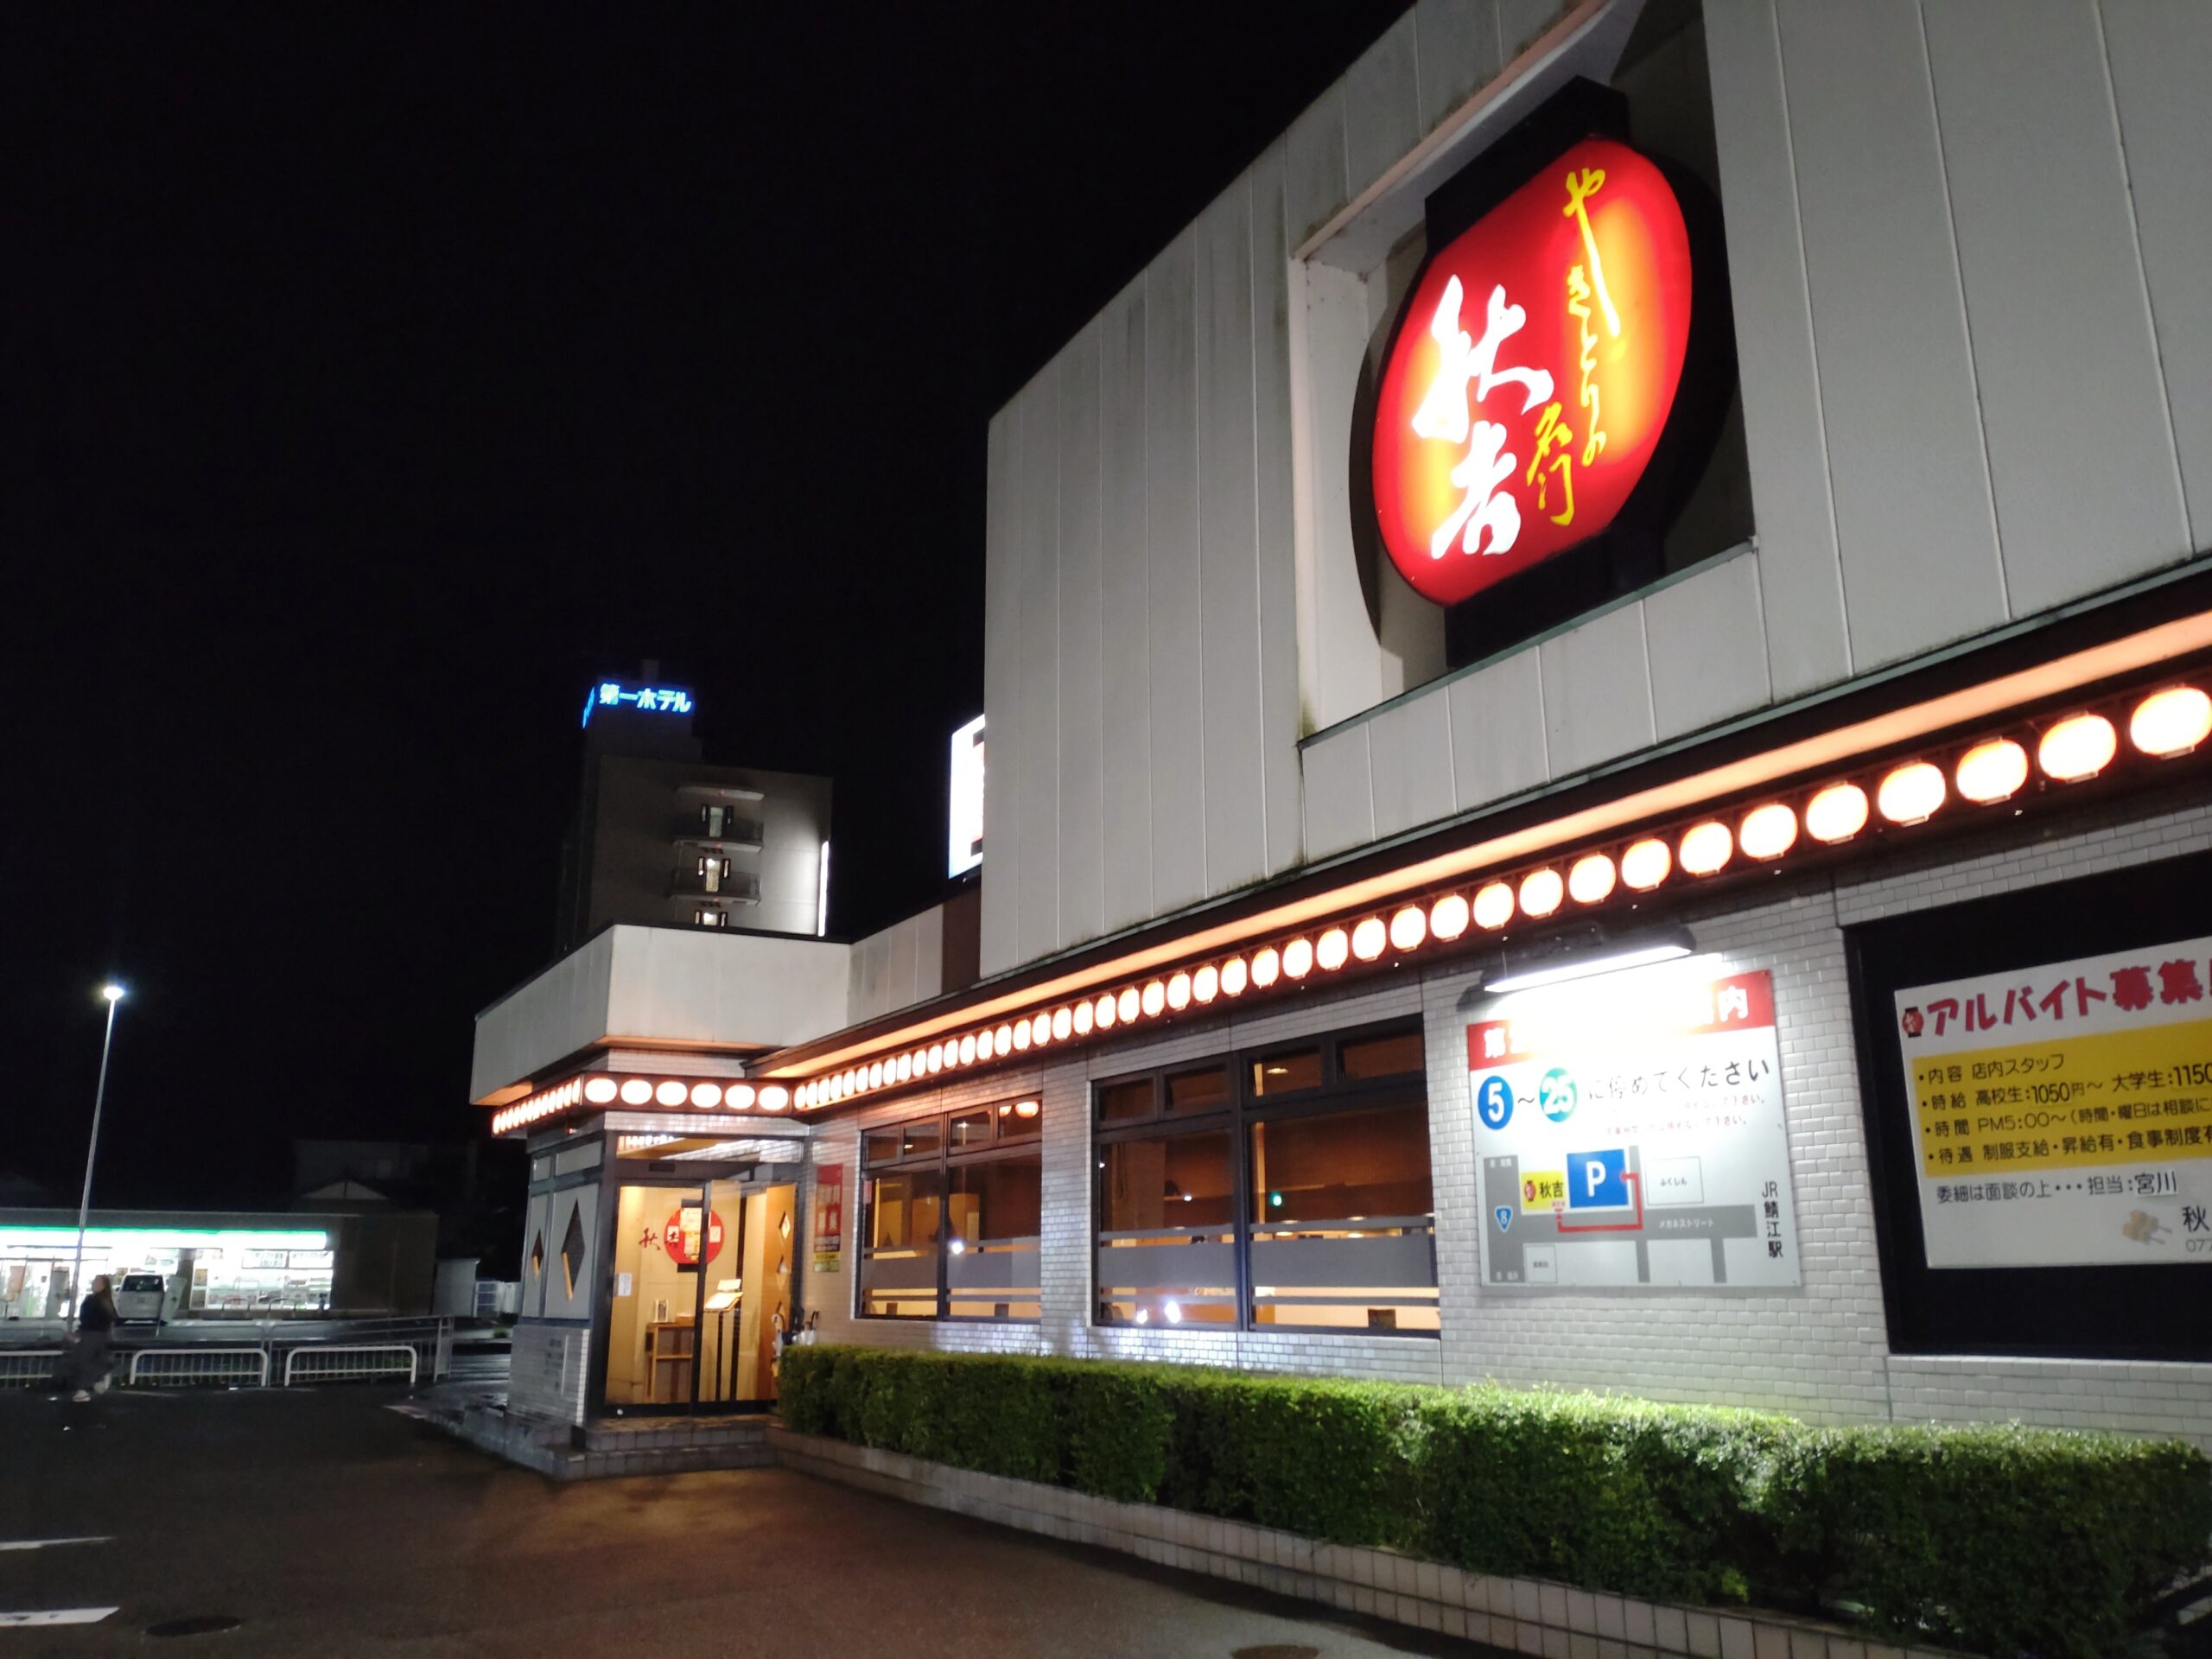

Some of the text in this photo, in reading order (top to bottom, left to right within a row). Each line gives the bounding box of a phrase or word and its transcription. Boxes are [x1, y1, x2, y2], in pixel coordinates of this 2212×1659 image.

[598, 683, 693, 714] 第一ホテル
[1926, 957, 2212, 1038] アルバイト募集
[1971, 1053, 2065, 1081] 店内スタッフ
[1539, 1180, 1564, 1199] 秋吉
[1585, 1160, 1606, 1198] P
[1500, 1211, 1508, 1225] 8
[2181, 1205, 2210, 1233] 秋
